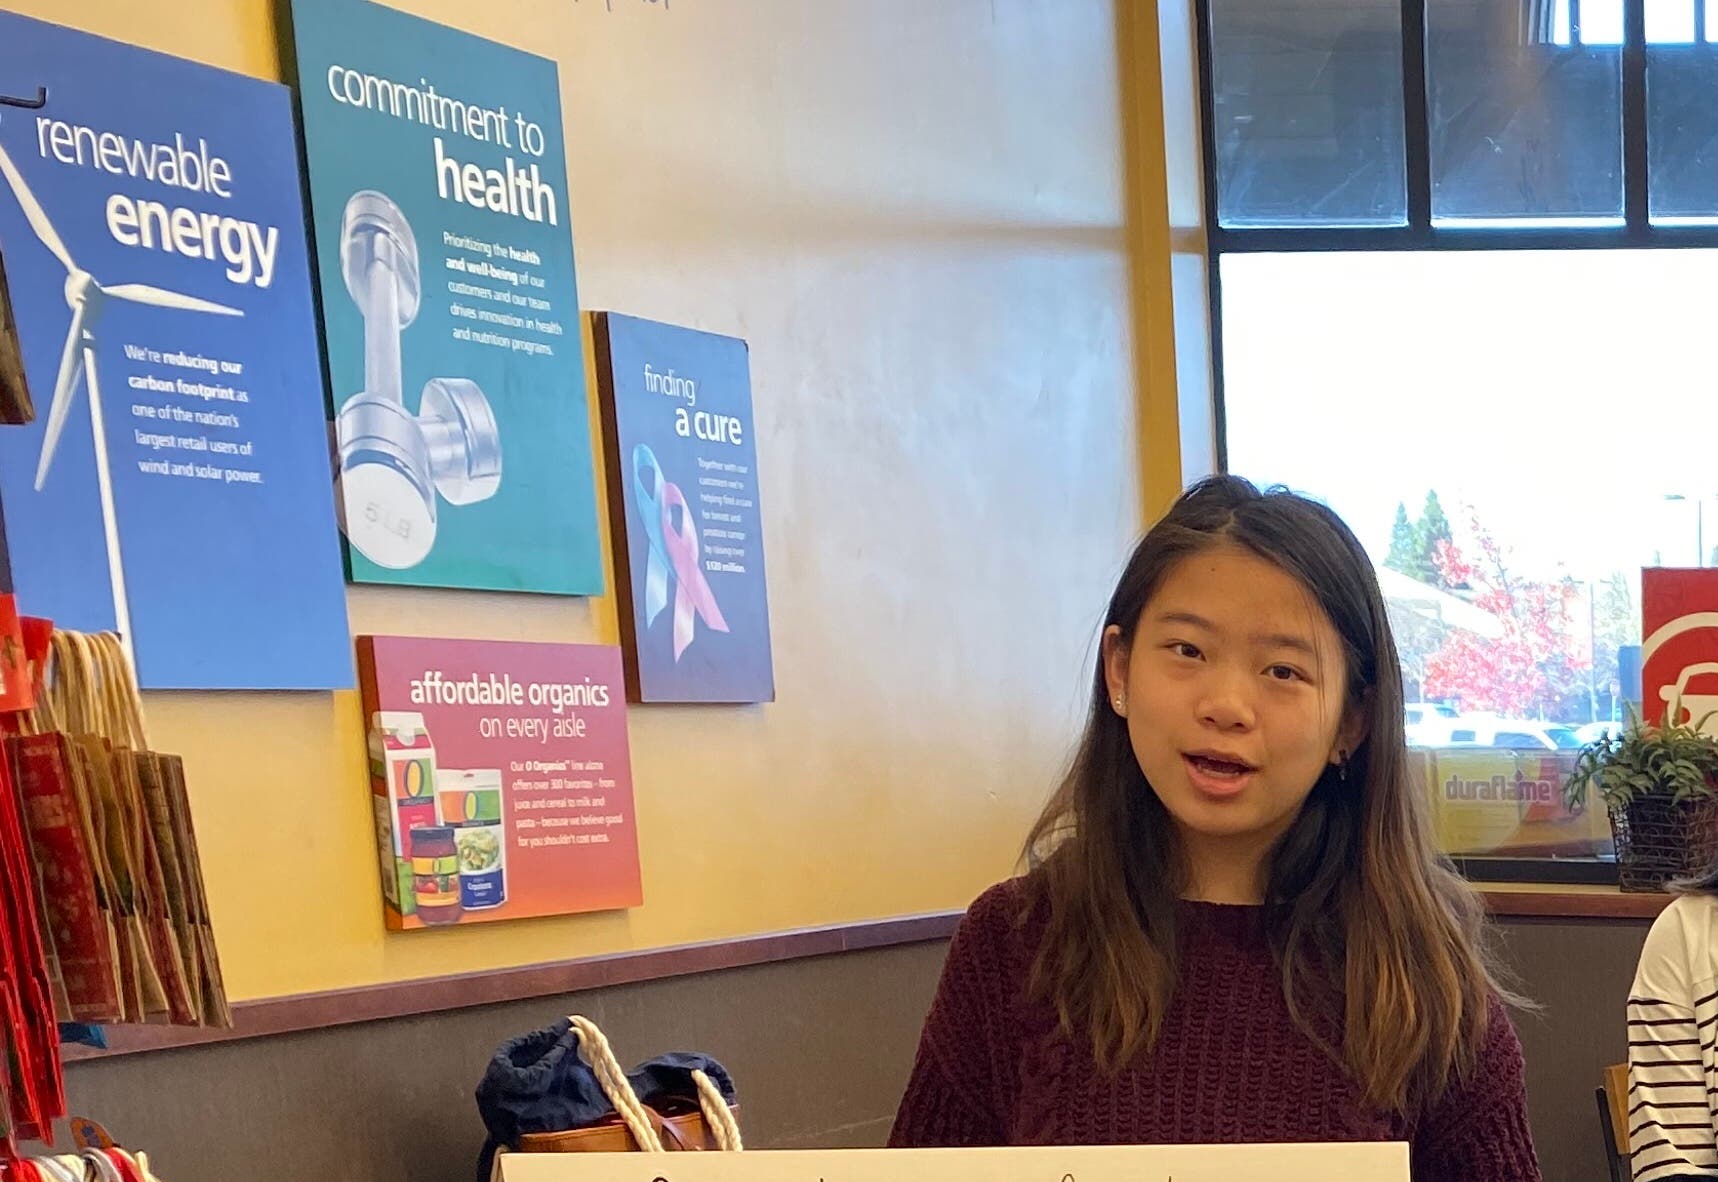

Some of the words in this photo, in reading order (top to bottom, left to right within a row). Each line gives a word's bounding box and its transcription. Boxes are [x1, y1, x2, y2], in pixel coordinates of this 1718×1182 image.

[327, 64, 512, 148] commitment
[514, 111, 544, 156] to
[36, 116, 231, 197] renewable
[433, 137, 557, 226] health
[106, 194, 279, 288] energy
[443, 231, 492, 257] Prioritizing
[493, 243, 508, 258] the
[509, 246, 541, 265] health
[446, 257, 465, 272] and
[466, 261, 518, 286] well-being
[519, 271, 528, 285] of
[530, 276, 545, 288] our
[448, 281, 492, 299] customers
[494, 290, 511, 303] and
[512, 295, 527, 307] our
[528, 296, 551, 311] team
[450, 302, 477, 319] drives
[478, 309, 524, 328] innovation
[526, 317, 534, 329] in
[535, 318, 562, 336] health
[452, 327, 471, 340] and
[471, 330, 510, 348] nutrition
[123, 344, 161, 363] We're
[163, 351, 218, 374] reducing
[221, 361, 243, 374] our
[128, 375, 174, 392] carbon
[176, 379, 235, 400] footprint
[236, 390, 249, 402] as
[644, 363, 696, 406] finding
[132, 404, 156, 418] one
[158, 404, 171, 419] of
[173, 407, 193, 422] the
[195, 411, 239, 427] nation's
[675, 407, 690, 437] a
[694, 411, 742, 445] cure
[134, 429, 176, 449] largest
[177, 436, 207, 450] retail
[209, 440, 239, 455] users
[239, 442, 252, 456] of
[138, 458, 169, 475] wind
[171, 462, 193, 477] and
[195, 464, 223, 479] solar
[410, 671, 524, 705] affordable
[528, 676, 610, 714] organics
[480, 717, 502, 738] on
[506, 717, 548, 744] every
[553, 713, 585, 738] aisle
[511, 761, 524, 771] Our
[571, 760, 583, 770] line
[584, 760, 604, 770] alone
[512, 779, 535, 790] offers
[536, 781, 549, 790] over
[564, 778, 593, 789] favorites
[599, 777, 615, 788] from
[1445, 773, 1551, 800] duraflame
[514, 799, 530, 811] juice
[532, 799, 546, 809] and
[547, 798, 567, 808] cereal
[568, 799, 575, 808] to
[576, 797, 590, 807] milk
[592, 797, 605, 806] and
[516, 819, 535, 830] pasta
[541, 816, 569, 826] because
[570, 817, 580, 826] we
[581, 814, 604, 825] believe
[606, 814, 623, 826] good
[518, 836, 528, 847] for
[530, 838, 543, 848] you
[544, 835, 575, 846] shouldn't
[576, 835, 590, 844] cost
